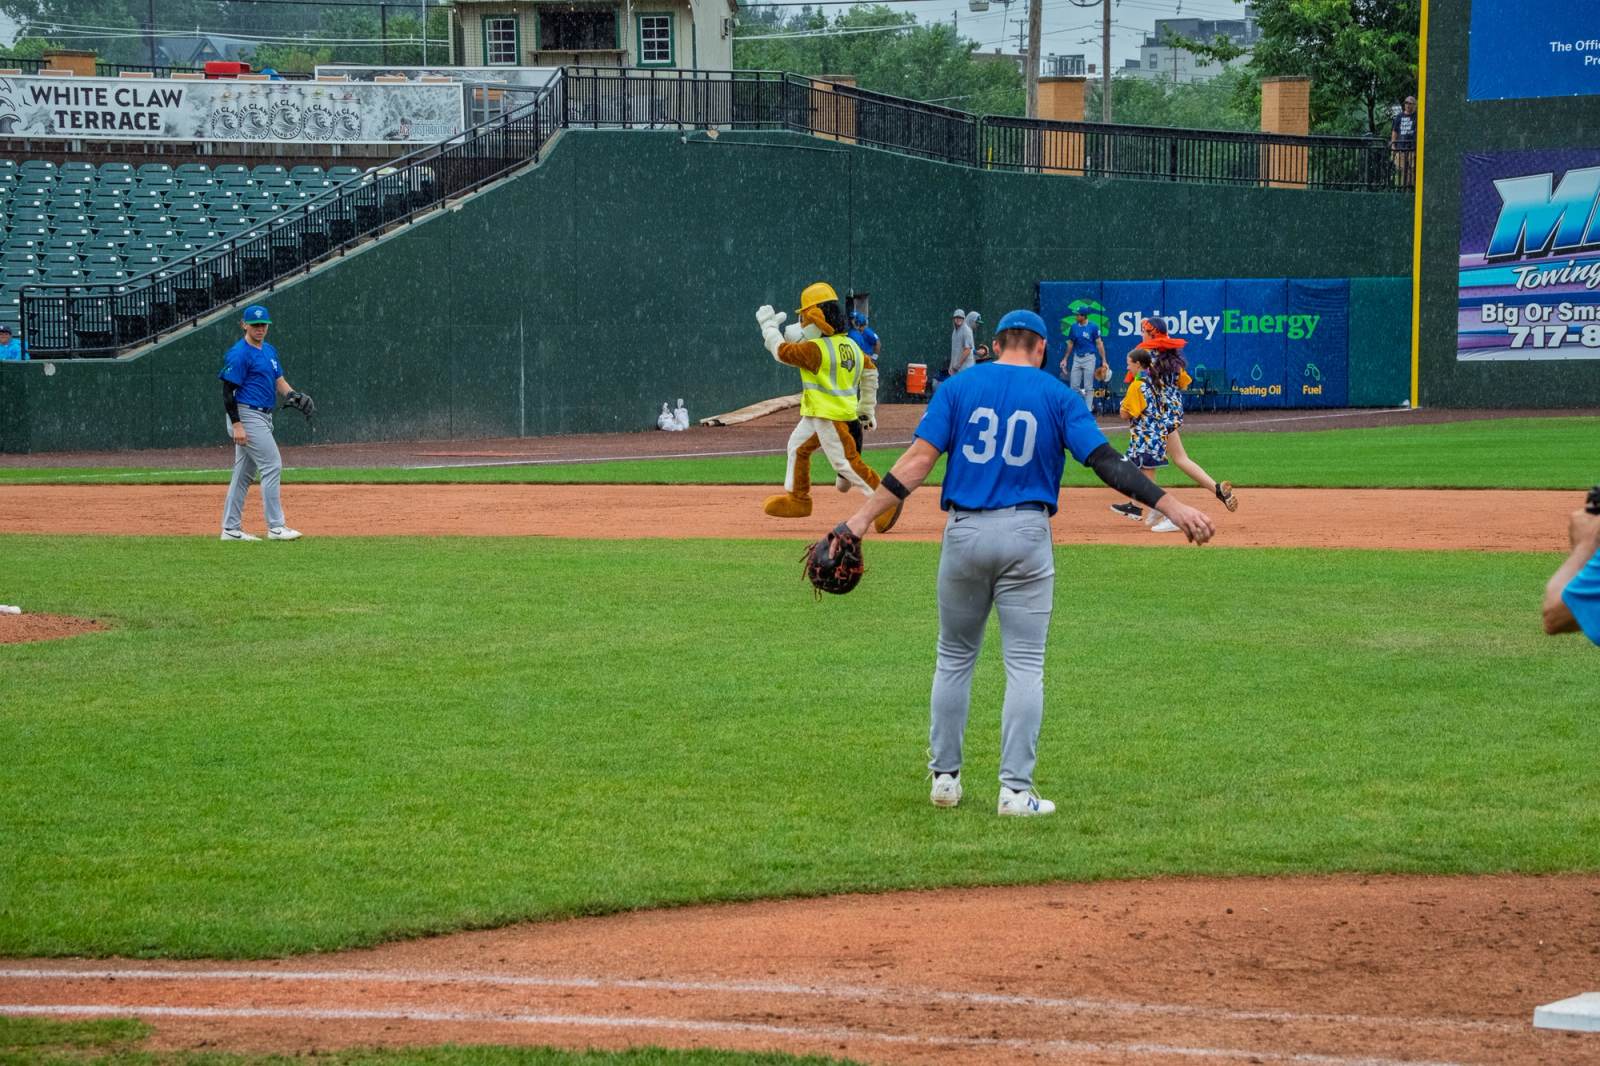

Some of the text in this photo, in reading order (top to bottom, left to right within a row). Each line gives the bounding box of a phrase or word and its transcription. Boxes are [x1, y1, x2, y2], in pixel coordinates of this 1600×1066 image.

[1549, 41, 1572, 52] The
[30, 85, 183, 108] WHITE CLAW
[54, 110, 161, 131] TERRACE
[1512, 260, 1600, 290] Towing
[1118, 310, 1321, 340] Shpley Energy
[1482, 303, 1519, 326] Big
[1524, 303, 1553, 322] Or
[1507, 324, 1600, 349] 717-8
[1268, 384, 1282, 395] Oil
[1302, 384, 1322, 395] Fuel
[962, 406, 1038, 467] 30
